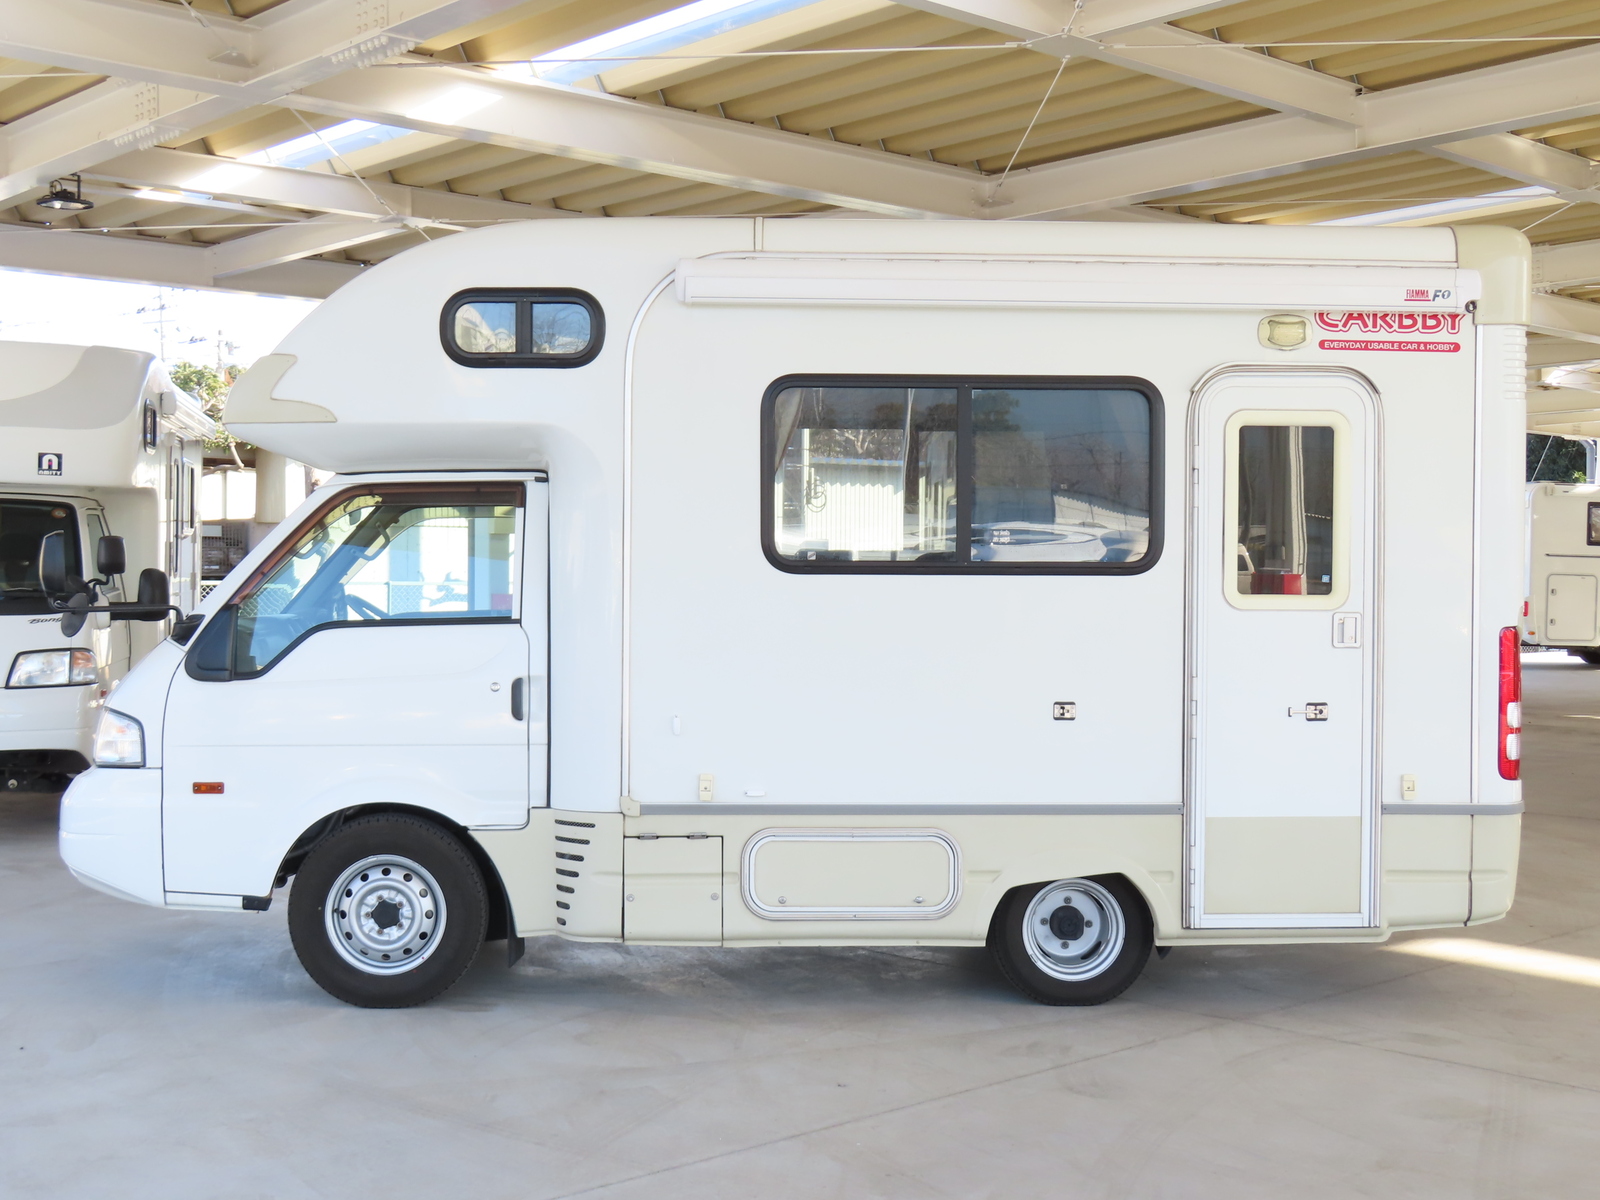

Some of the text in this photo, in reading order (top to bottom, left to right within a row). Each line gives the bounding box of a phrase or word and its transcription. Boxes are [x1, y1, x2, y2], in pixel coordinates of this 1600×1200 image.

[1406, 288, 1429, 299] FIAMMA
[1324, 341, 1366, 349] EVERYDAY
[1367, 342, 1399, 350] USABLE
[1400, 342, 1418, 350] CAR
[1426, 343, 1455, 351] HOBBY
